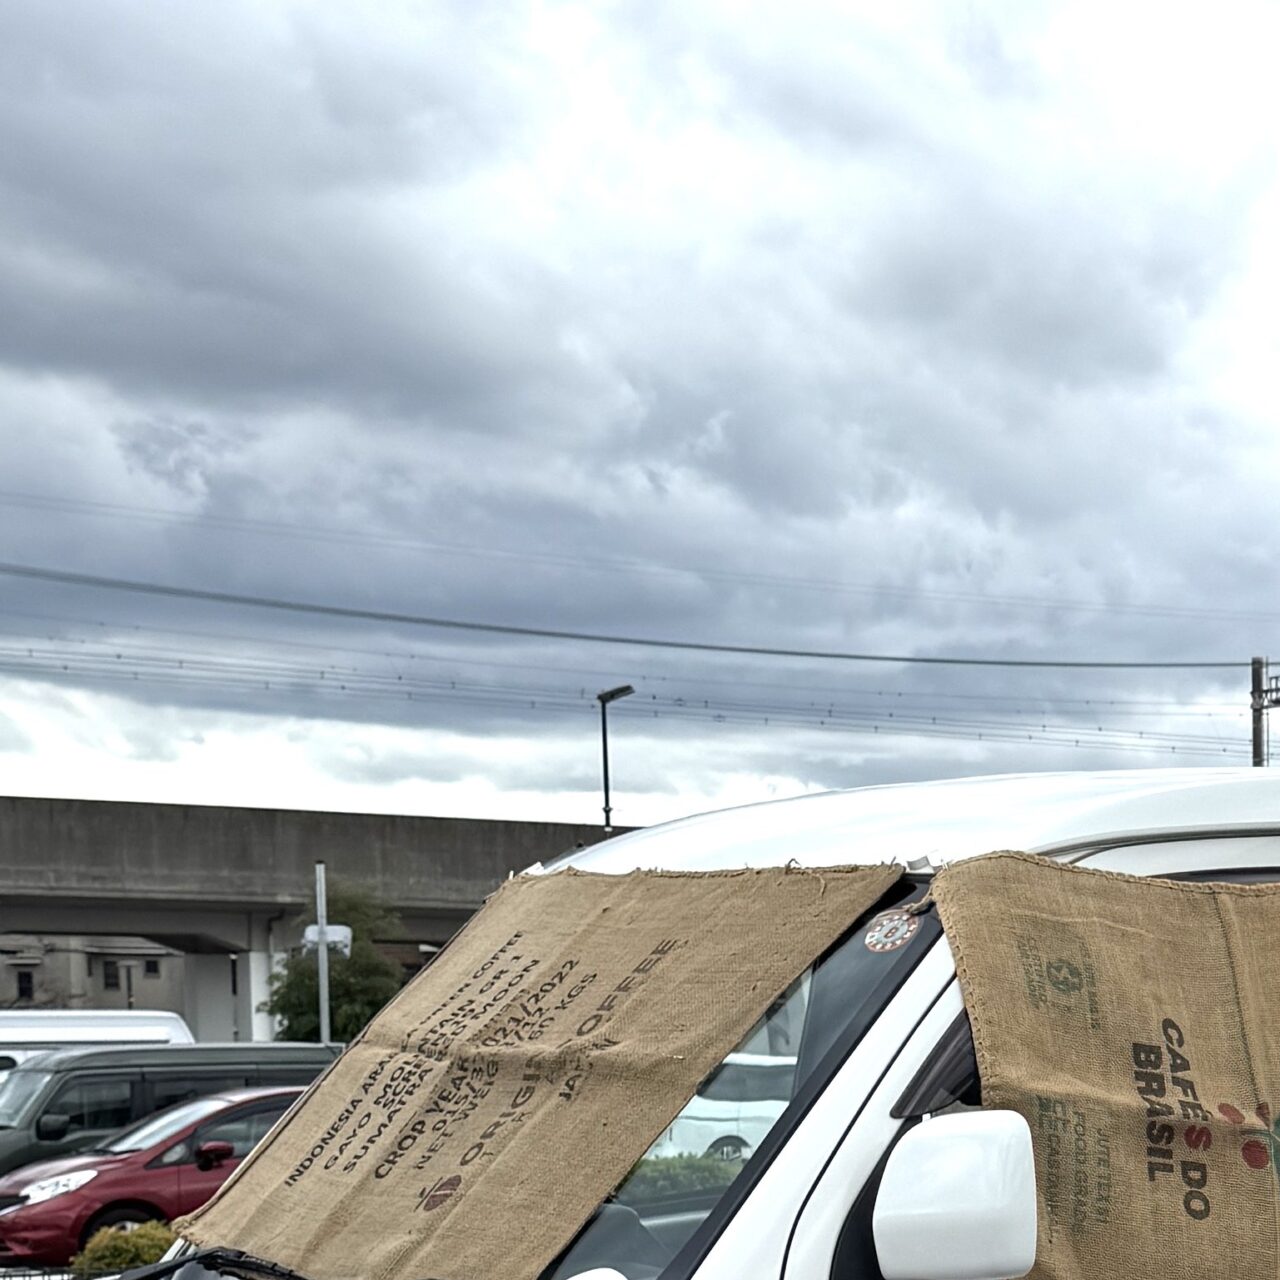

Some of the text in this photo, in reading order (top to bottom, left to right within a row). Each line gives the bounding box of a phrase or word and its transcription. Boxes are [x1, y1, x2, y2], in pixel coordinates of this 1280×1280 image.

[343, 1067, 434, 1173] SUMATRA
[470, 959, 541, 1021] MOON
[413, 1130, 454, 1170] NET
[555, 972, 598, 1012] KGS
[285, 1098, 363, 1187] INDONESIA
[323, 1112, 372, 1170] GAYO
[374, 1120, 427, 1180] CROP
[1132, 1042, 1175, 1182] BRASIL
[1180, 1159, 1211, 1221] DO
